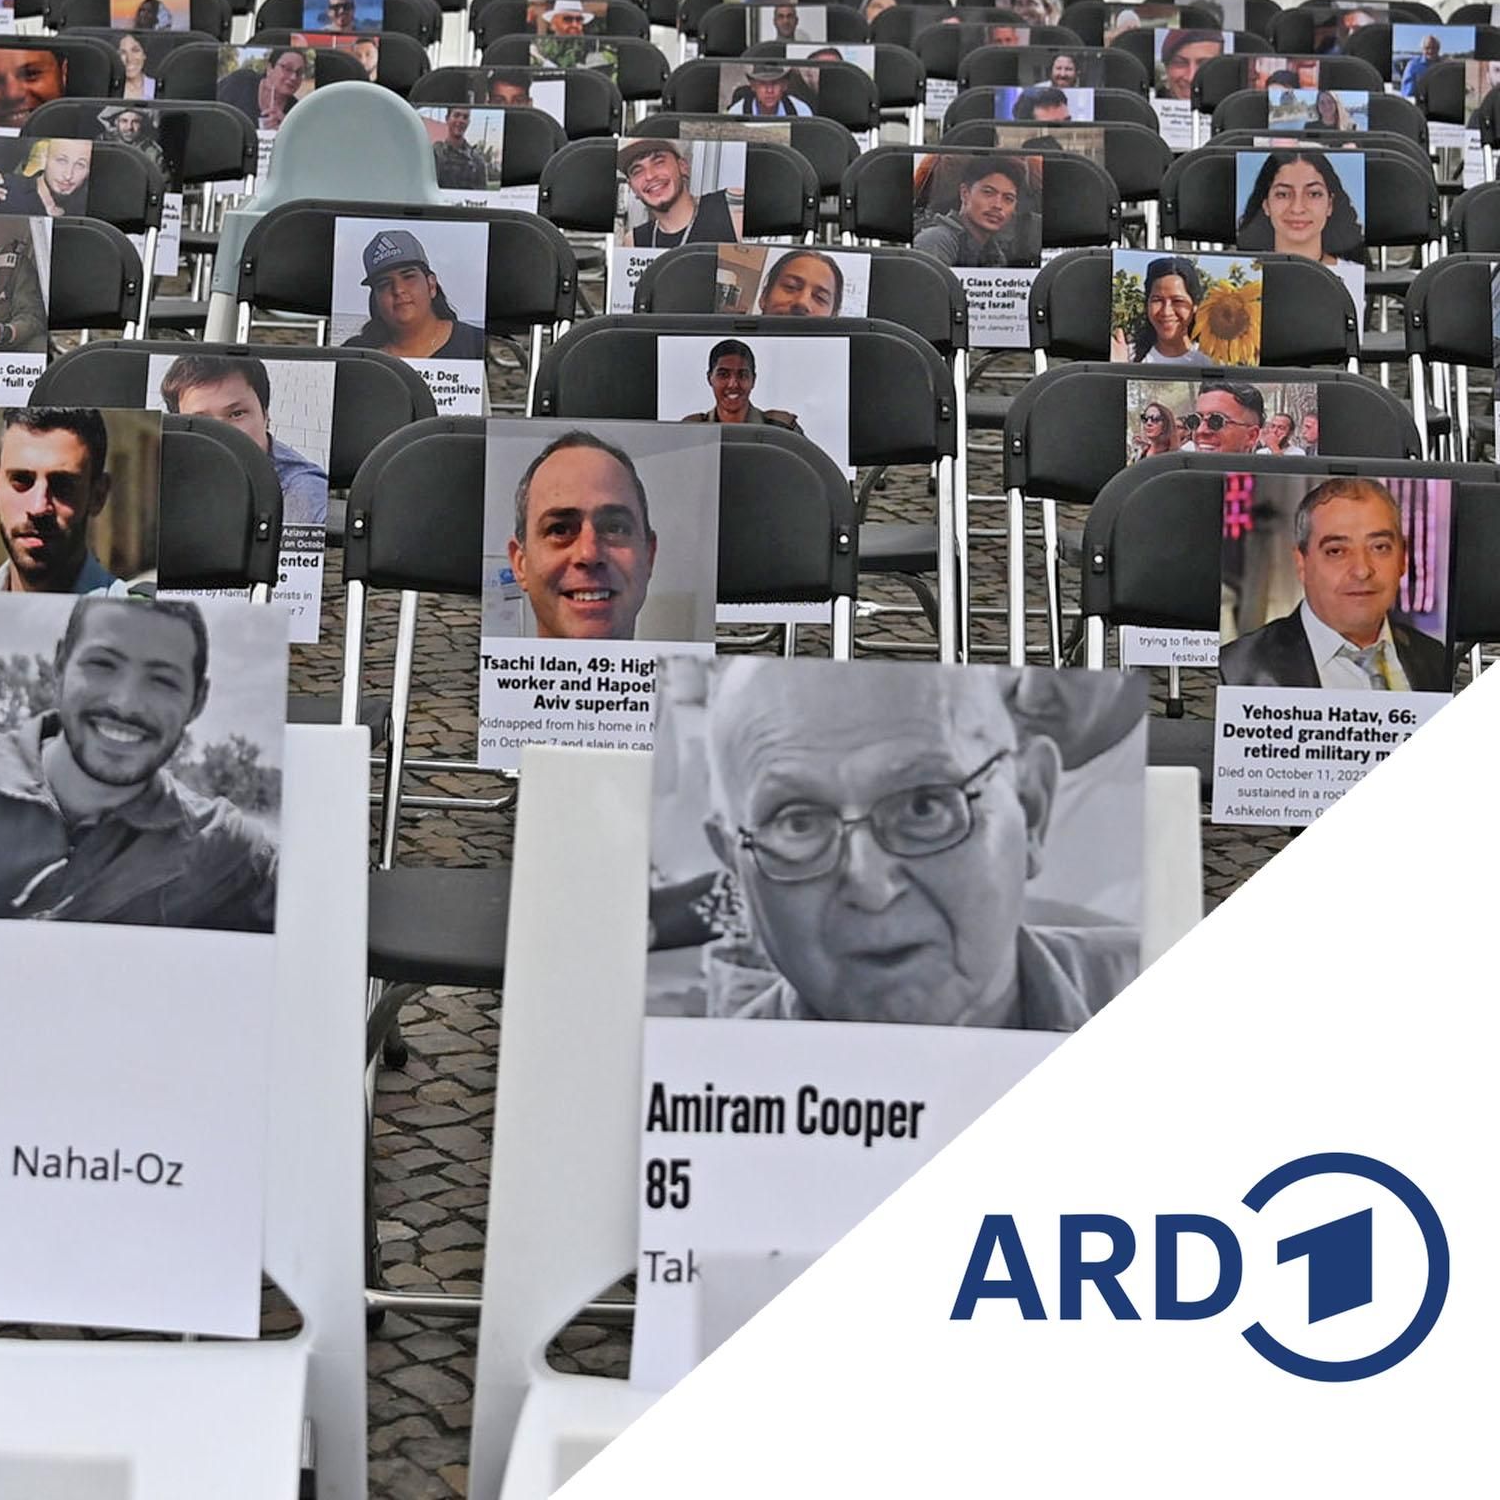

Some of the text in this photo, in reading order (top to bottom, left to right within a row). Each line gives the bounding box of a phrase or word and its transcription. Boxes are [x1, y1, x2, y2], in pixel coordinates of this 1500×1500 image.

[966, 277, 1032, 288] Class Cedrick
[996, 290, 1027, 301] calling
[988, 300, 1015, 309] Israel
[988, 324, 1014, 333] January
[6, 364, 43, 375] Golani
[437, 370, 460, 383] Dog
[303, 591, 313, 600] in
[1139, 636, 1167, 647] trying
[1170, 637, 1181, 646] to
[1183, 636, 1201, 646] flee
[1172, 652, 1208, 662] festival
[480, 654, 616, 675] Tsachi Idan, 49:
[497, 675, 657, 695] worker and Hapoel
[533, 694, 650, 714] Aviv superfan
[1242, 704, 1417, 726] Yehoshua Hatav, 66:
[479, 717, 542, 731] Kidnapped
[546, 718, 574, 730] from
[577, 719, 595, 731] his
[598, 720, 632, 732] home
[635, 722, 646, 732] in
[1223, 723, 1293, 740] Devoted
[1297, 726, 1399, 744] grandfather
[481, 739, 496, 748] on
[618, 741, 628, 750] in
[1244, 743, 1370, 765] retired military
[1218, 766, 1335, 782] Died on October 11,
[1238, 787, 1320, 799] sustained in a
[1225, 804, 1312, 818] Ashkelon from
[646, 1083, 924, 1146] Amiram Cooper
[12, 1146, 184, 1188] Nahal-Oz
[646, 1159, 690, 1210] 85
